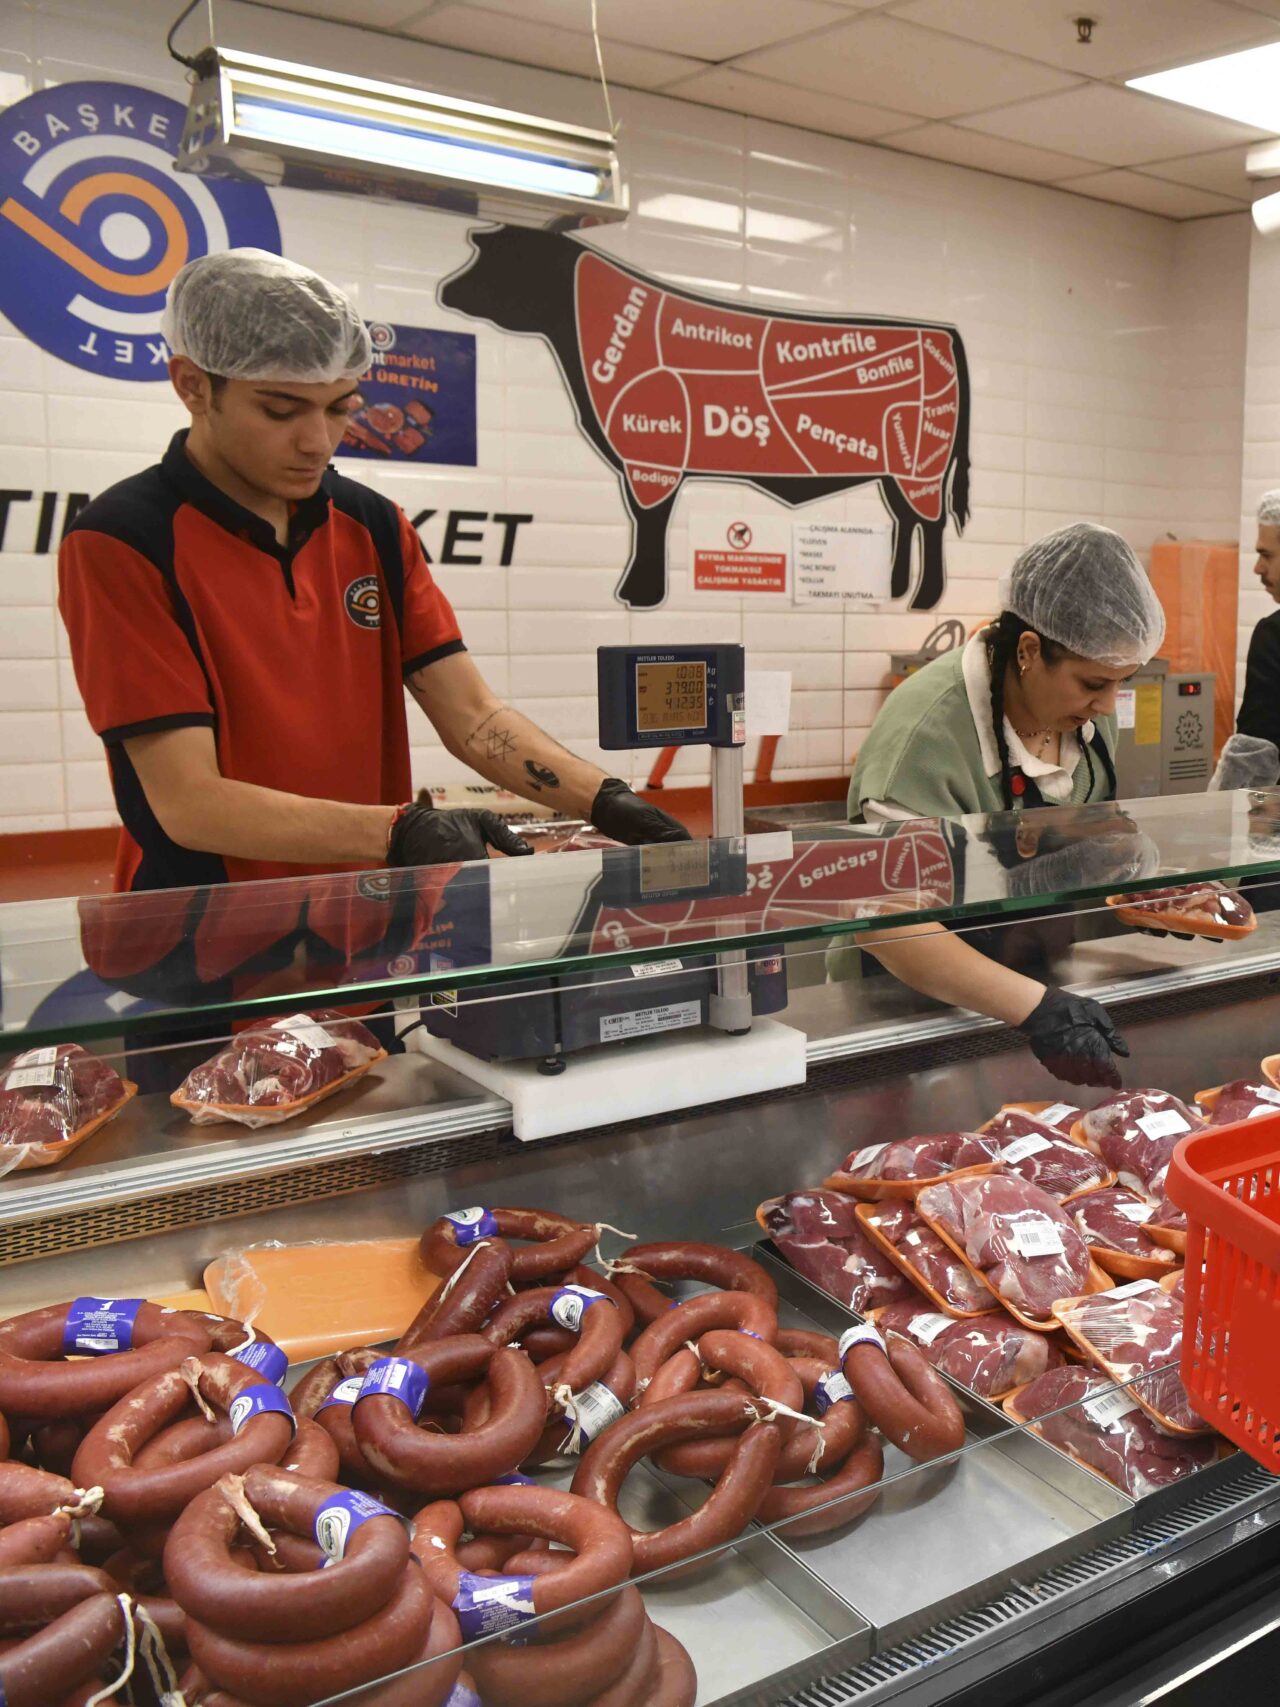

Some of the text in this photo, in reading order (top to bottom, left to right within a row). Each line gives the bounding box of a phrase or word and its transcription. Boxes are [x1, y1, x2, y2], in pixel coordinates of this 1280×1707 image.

[12, 103, 170, 157] BAŞKE
[78, 331, 170, 365] KET
[591, 285, 648, 385] Gerdan
[670, 317, 754, 350] Antrikot
[776, 331, 877, 364] Kontrfile
[371, 351, 436, 372] ntmarket
[856, 354, 915, 384] Bonfile
[923, 338, 956, 376] Sokum
[377, 369, 439, 394] ÜRETİM
[622, 411, 683, 434] Kürek
[703, 404, 772, 447] Döş
[923, 399, 956, 420] Tranç
[796, 413, 879, 461] Pençata
[891, 411, 914, 471] Yumurta
[923, 418, 952, 441] Nuar
[631, 469, 678, 487] Bodigo
[908, 482, 940, 501] Bodigo
[400, 508, 534, 567] KET
[698, 553, 725, 562] KIYMA
